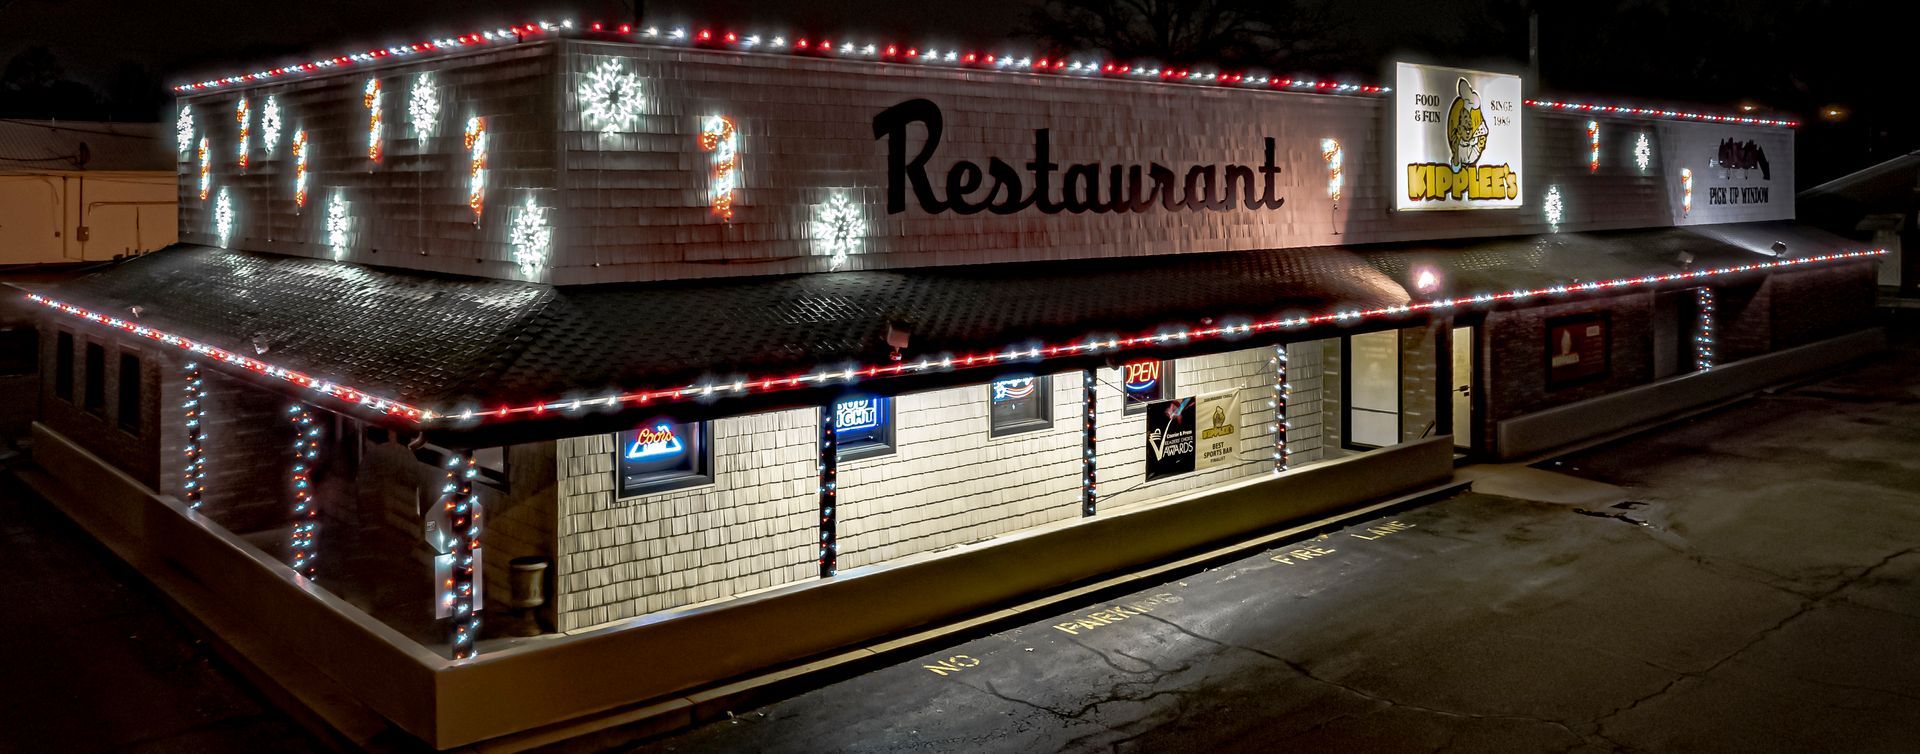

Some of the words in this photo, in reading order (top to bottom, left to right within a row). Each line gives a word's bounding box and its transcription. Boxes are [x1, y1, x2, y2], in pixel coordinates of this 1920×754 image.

[1415, 94, 1440, 107] FOOD
[1491, 100, 1513, 112] SINCE
[1414, 110, 1421, 122] &
[1423, 111, 1441, 123] FUN
[872, 99, 1285, 215] Restaurant
[1709, 187, 1727, 205] PICK
[1729, 187, 1740, 204] UP
[1741, 187, 1769, 204] WINDOW
[638, 428, 674, 446] Coors
[1163, 441, 1194, 458] AWARDS
[1203, 448, 1222, 459] SPORTS
[1223, 446, 1233, 455] BAR
[1212, 441, 1224, 450] BEST
[923, 655, 981, 676] NO
[1270, 545, 1336, 565] FIRE
[1350, 521, 1417, 540] LANE
